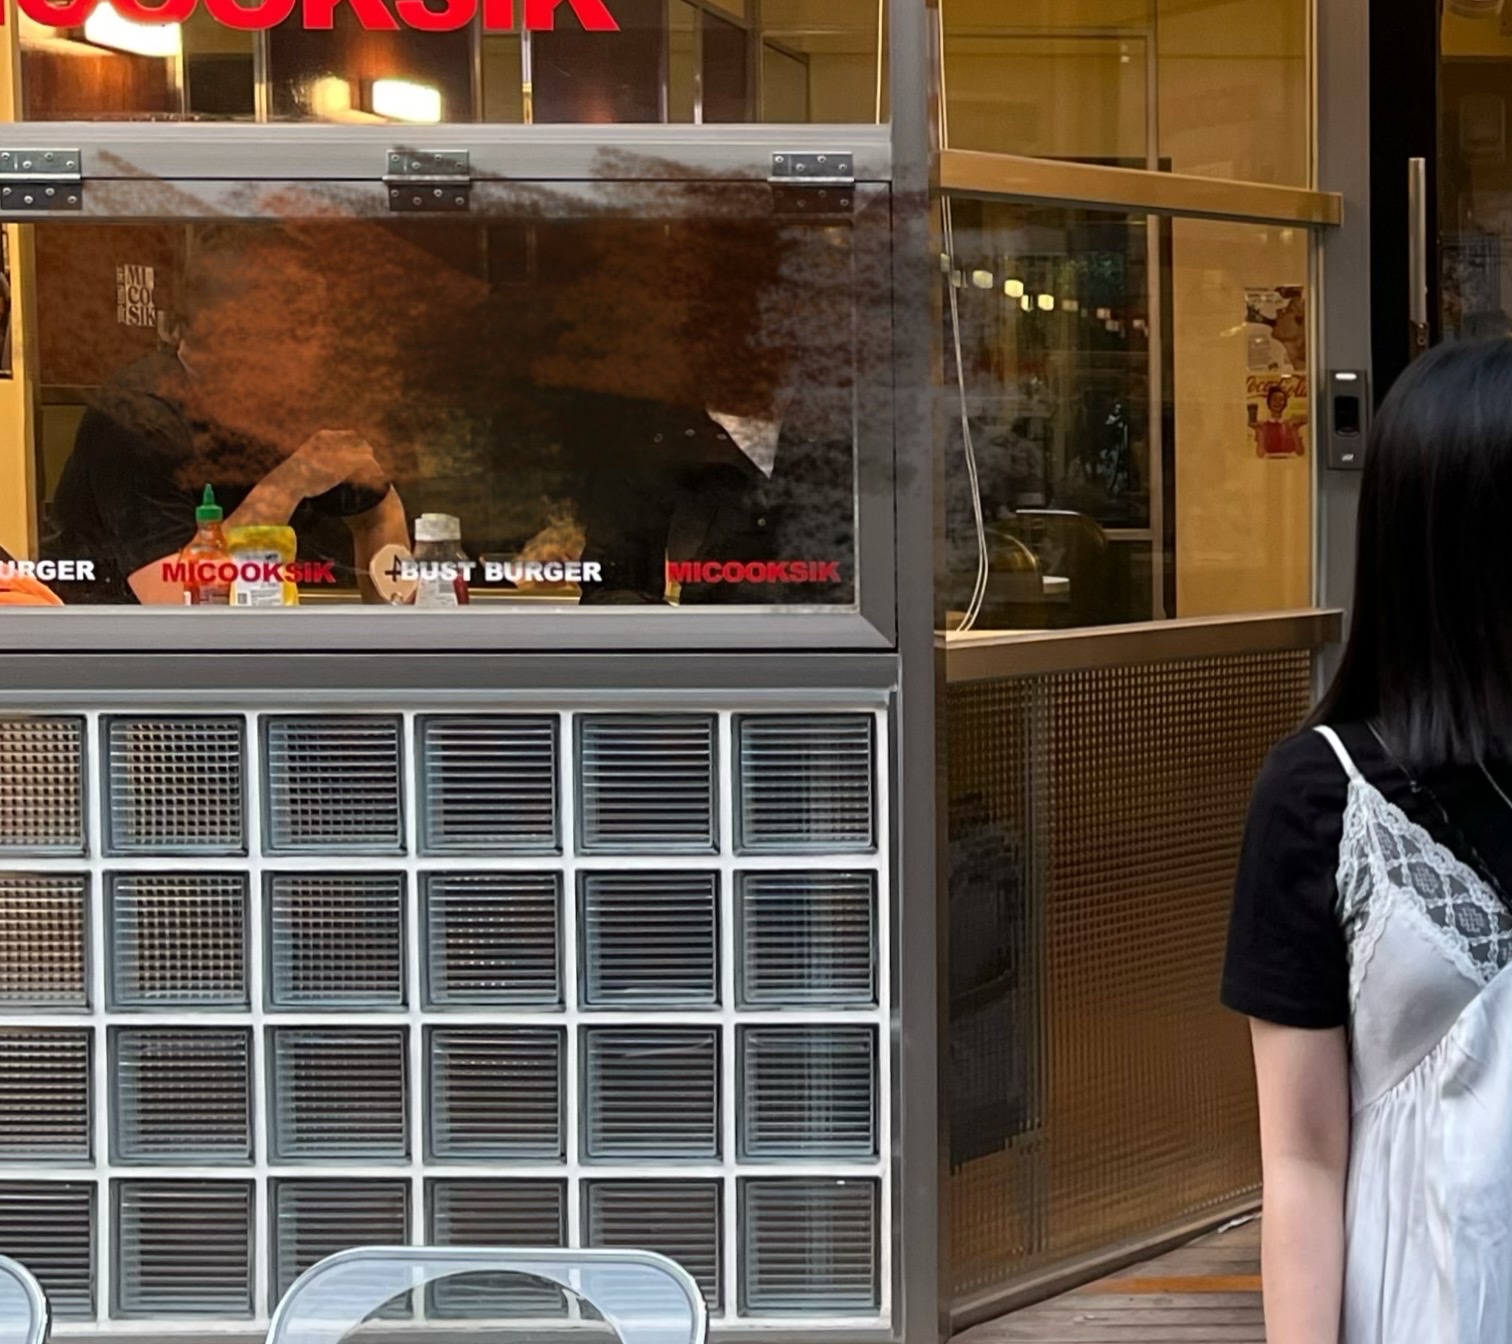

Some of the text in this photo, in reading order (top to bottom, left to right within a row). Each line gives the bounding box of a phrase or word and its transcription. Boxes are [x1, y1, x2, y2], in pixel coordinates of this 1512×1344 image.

[128, 286, 155, 305] CO
[161, 561, 336, 583] MICOOKSIK
[399, 561, 603, 582] BUST BURGER
[666, 561, 842, 583] MICOOKSIK
